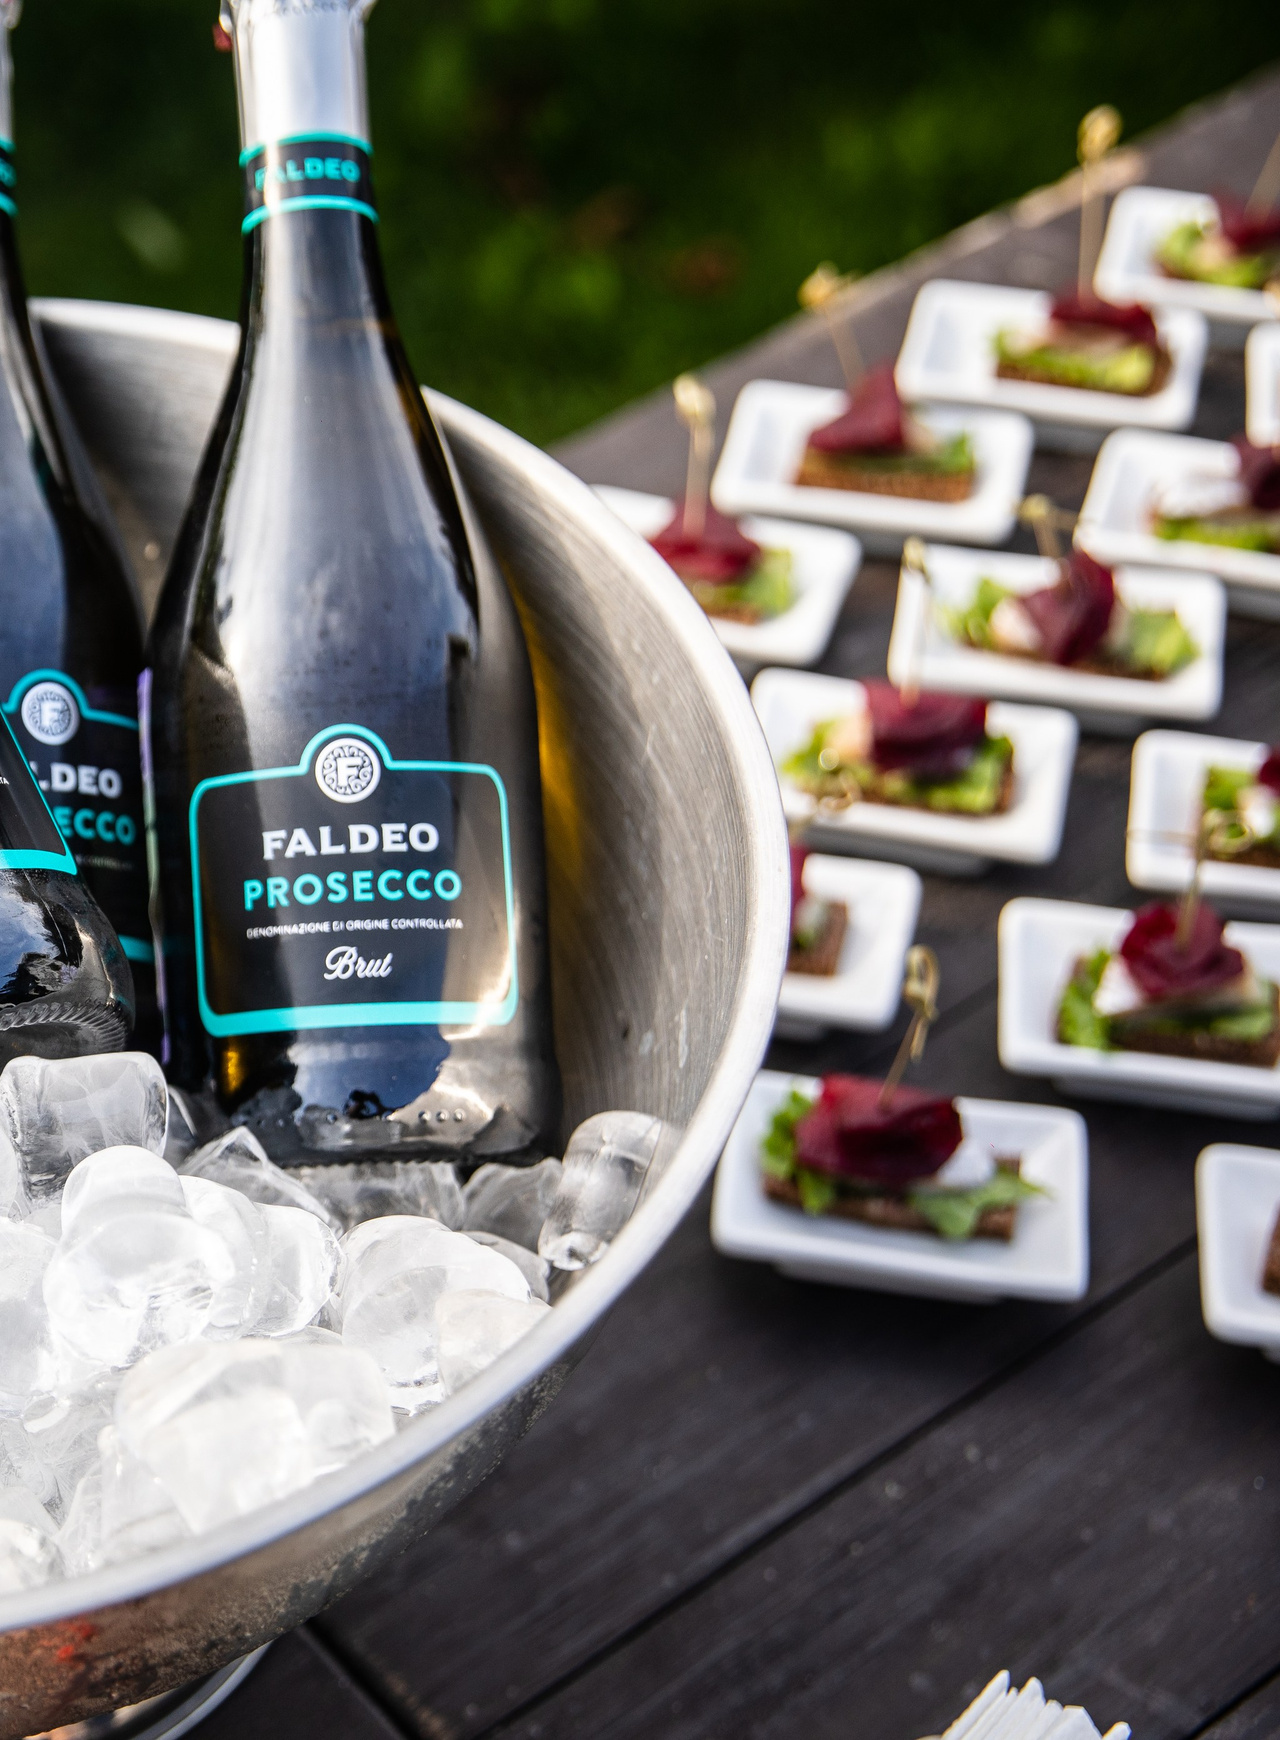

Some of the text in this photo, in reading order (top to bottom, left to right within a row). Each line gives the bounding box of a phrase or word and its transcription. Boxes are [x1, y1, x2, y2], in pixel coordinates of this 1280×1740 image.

[262, 822, 440, 861] FALDEO
[243, 868, 463, 912] PROSECCO
[246, 917, 464, 940] DENOMINAZIONE DI ORIGINE CONTROLLATA
[323, 945, 394, 980] Brut
